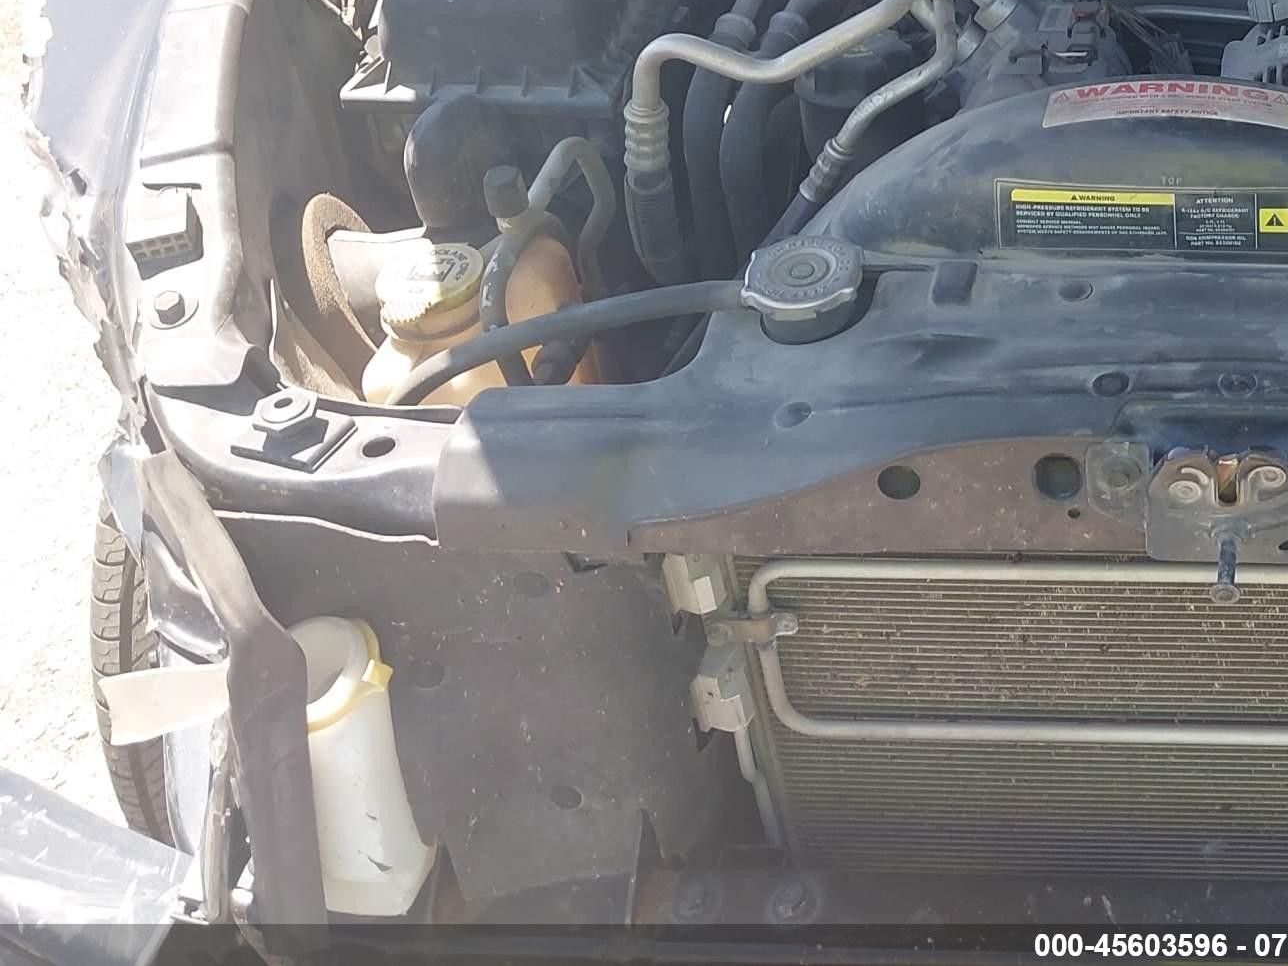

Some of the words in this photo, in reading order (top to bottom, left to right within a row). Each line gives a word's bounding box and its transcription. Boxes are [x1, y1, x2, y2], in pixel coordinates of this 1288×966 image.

[1076, 82, 1269, 102] WARNING
[1160, 176, 1183, 185] TOP
[1078, 194, 1116, 202] WARNING
